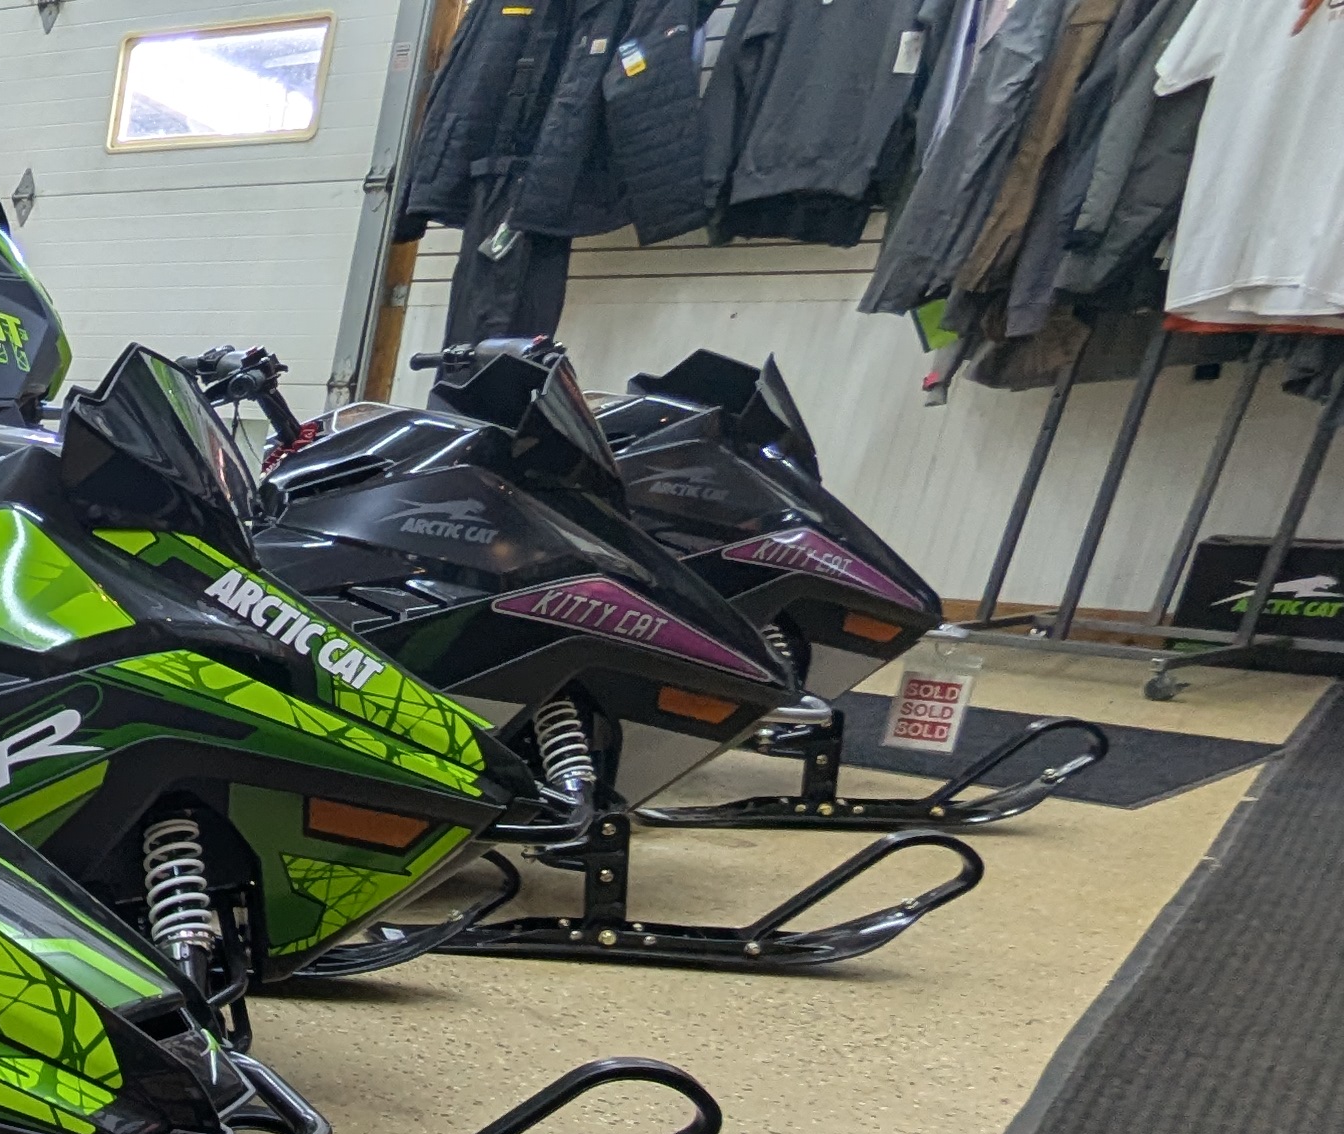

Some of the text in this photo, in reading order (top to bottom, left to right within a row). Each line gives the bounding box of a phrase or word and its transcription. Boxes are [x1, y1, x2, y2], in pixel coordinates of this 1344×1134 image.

[647, 481, 701, 498] ARCTIC
[399, 517, 500, 545] ARCTIC CAT
[752, 537, 853, 577] KITTY CAT
[530, 589, 669, 641] KITTY CAT
[1303, 600, 1344, 618] CAT
[204, 569, 384, 692] ARCTIC CAT
[905, 682, 962, 701] SOLD
[900, 701, 954, 720] SOLD
[894, 721, 949, 739] SOLD
